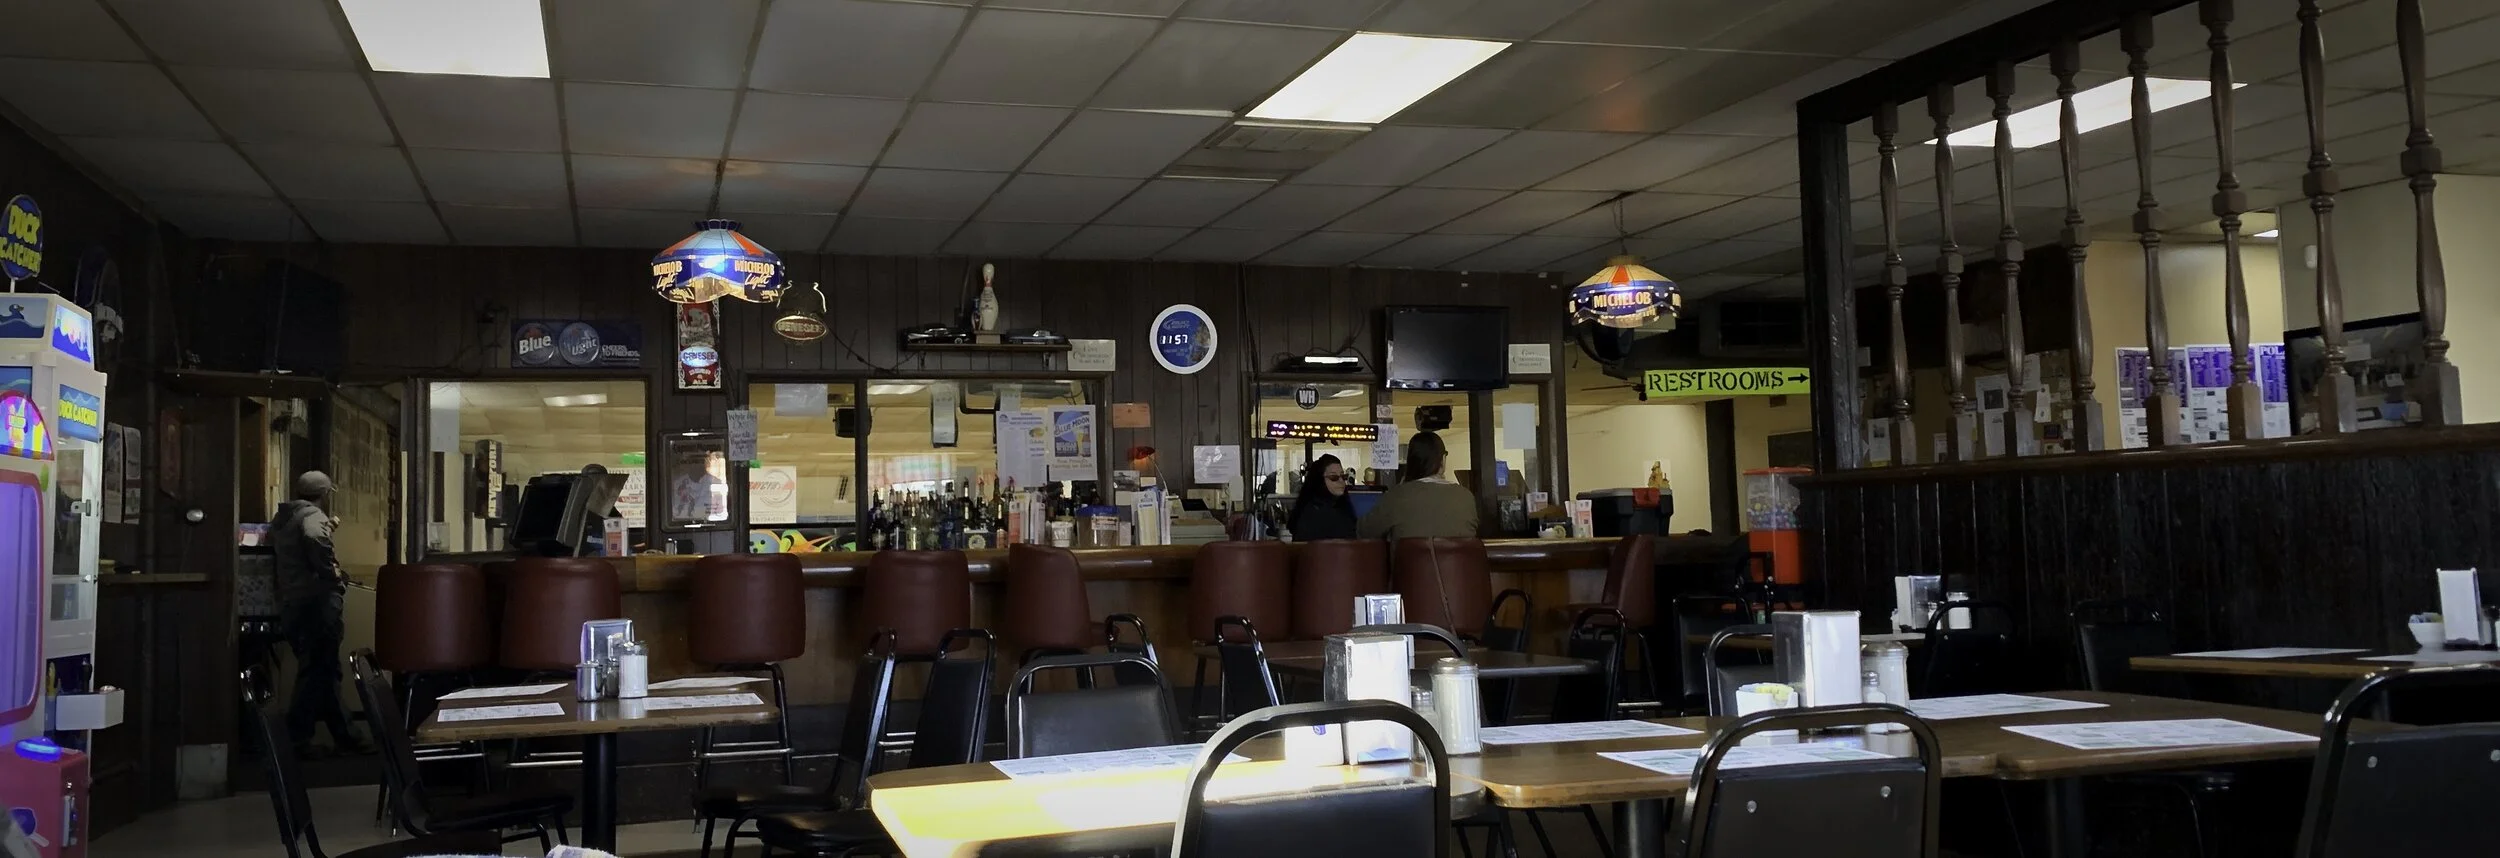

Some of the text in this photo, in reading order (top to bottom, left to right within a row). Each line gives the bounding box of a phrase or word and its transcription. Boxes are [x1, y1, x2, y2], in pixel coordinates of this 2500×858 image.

[7, 204, 41, 246] DUCK
[734, 259, 775, 276] MICHELOB
[744, 273, 773, 291] Light
[1593, 291, 1652, 309] MICHELOB
[519, 335, 552, 355] Blue
[683, 351, 715, 361] GENESEE
[1648, 370, 1784, 392] RESTROOMS
[1298, 390, 1316, 404] WH
[1054, 416, 1090, 435] BLUE MOON
